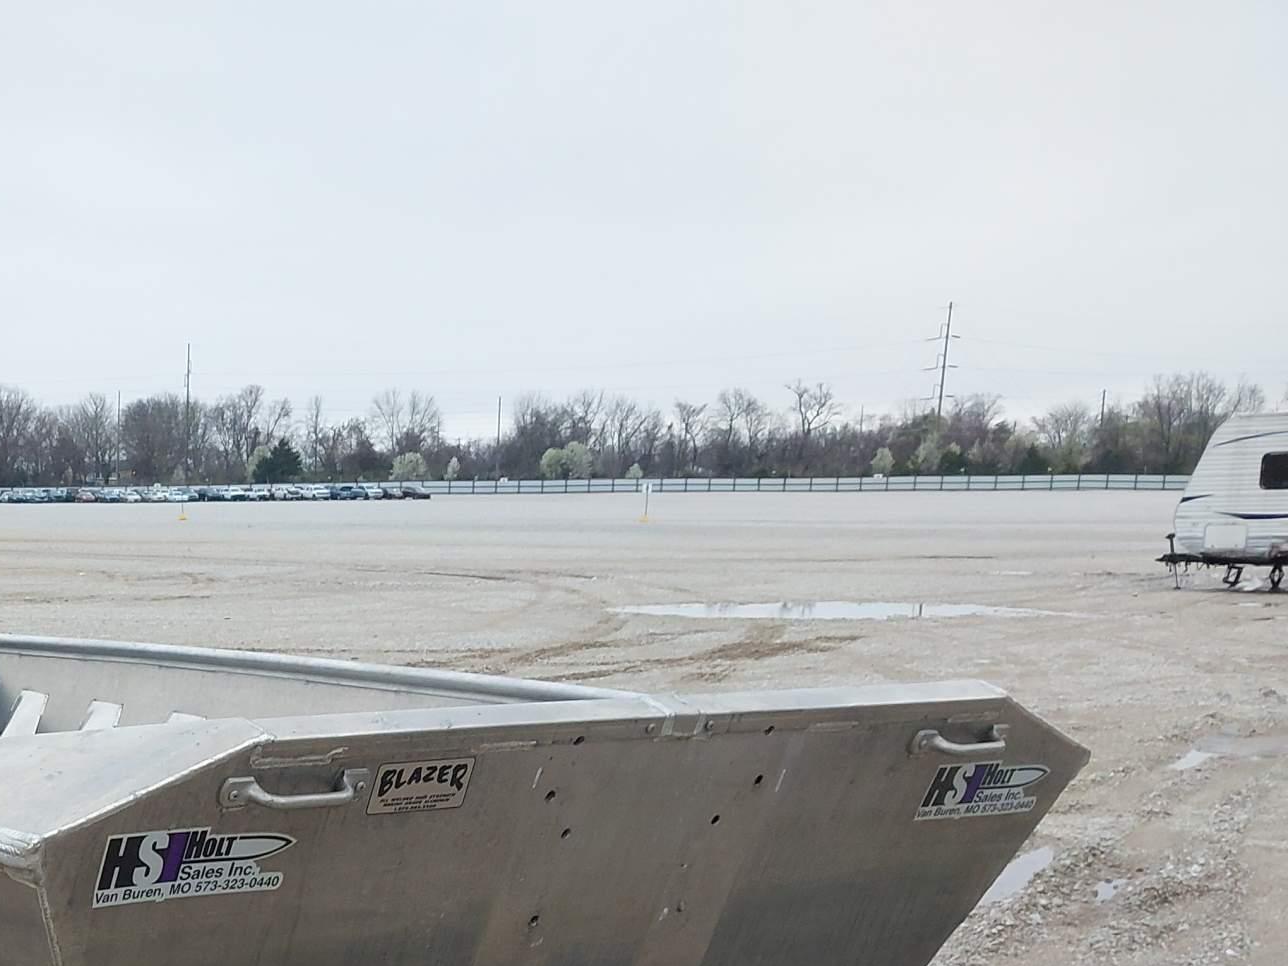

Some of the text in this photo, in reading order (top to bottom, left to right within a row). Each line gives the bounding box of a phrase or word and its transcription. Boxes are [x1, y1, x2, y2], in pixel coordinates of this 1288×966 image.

[377, 763, 468, 798] BLAZER
[981, 763, 1017, 786] HOLT
[973, 791, 1004, 803] Sales
[185, 830, 238, 859] HOLT
[179, 861, 256, 881] Sales Inc.
[95, 875, 280, 905] Van Buren, MO 573-323-0440
